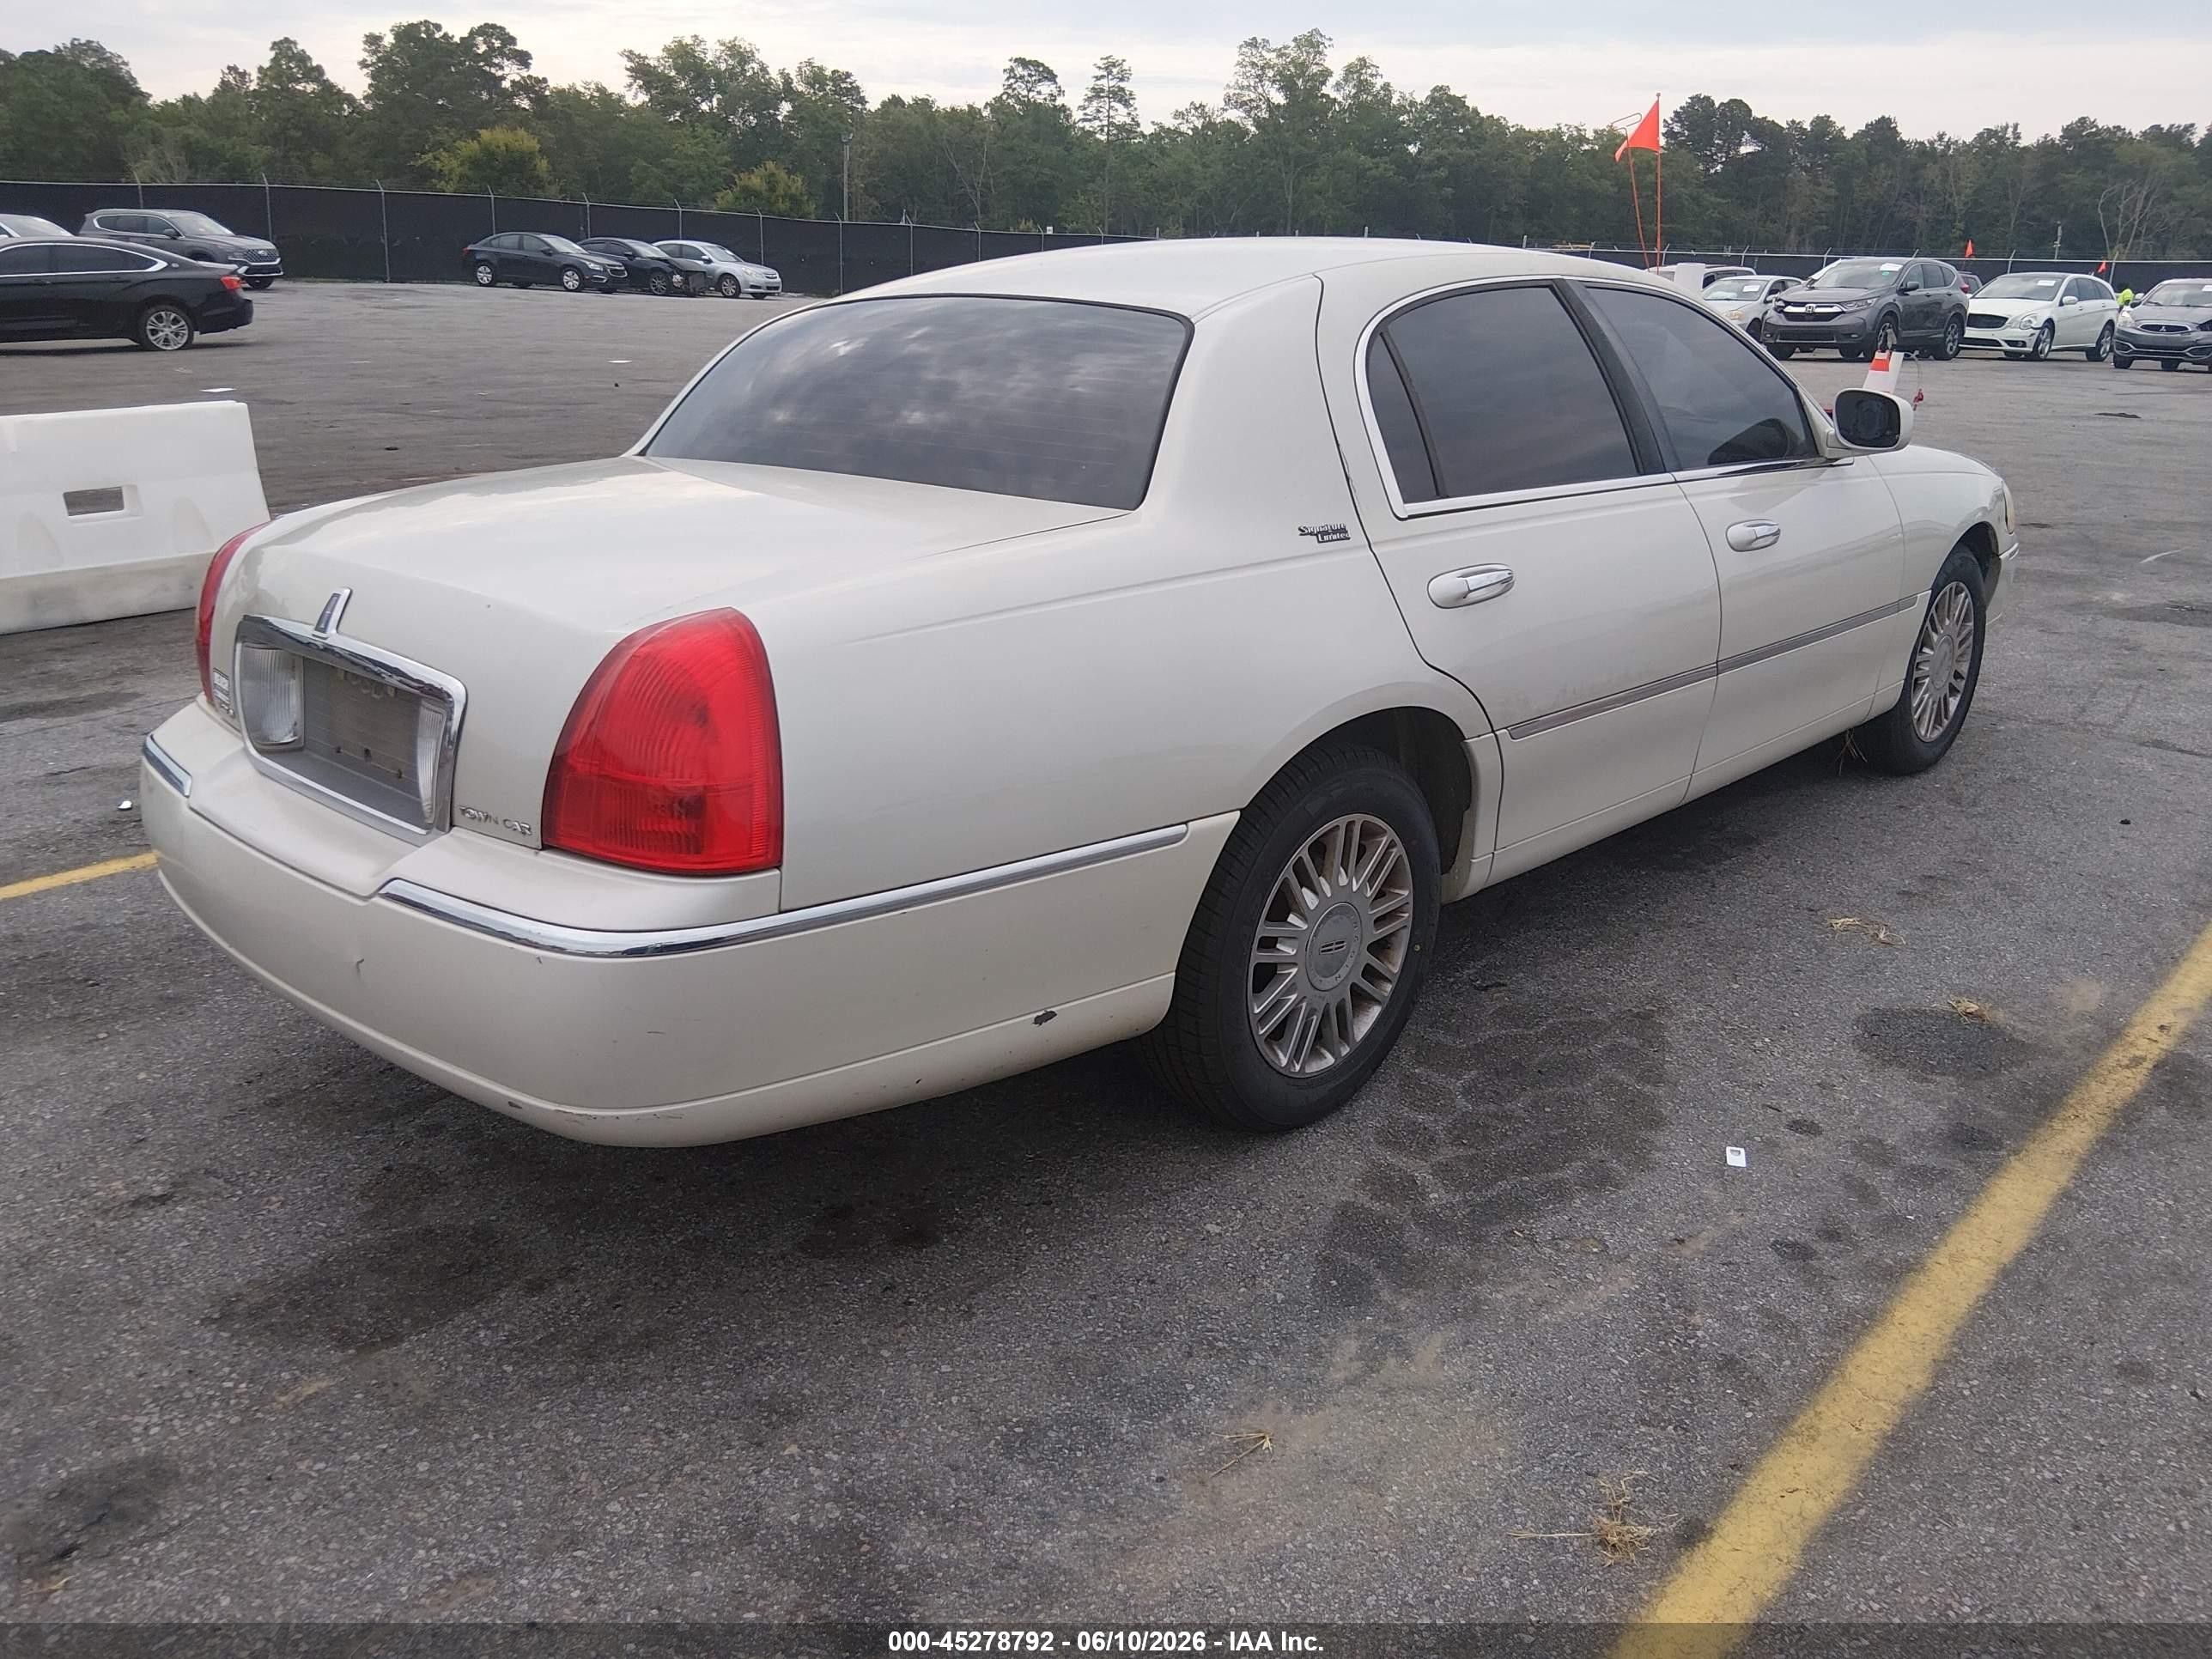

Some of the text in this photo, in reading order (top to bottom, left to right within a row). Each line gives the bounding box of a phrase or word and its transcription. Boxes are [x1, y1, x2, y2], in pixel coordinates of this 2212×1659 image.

[1297, 522, 1346, 534] Signature
[1317, 529, 1351, 543] Limited
[503, 818, 532, 836] CAR
